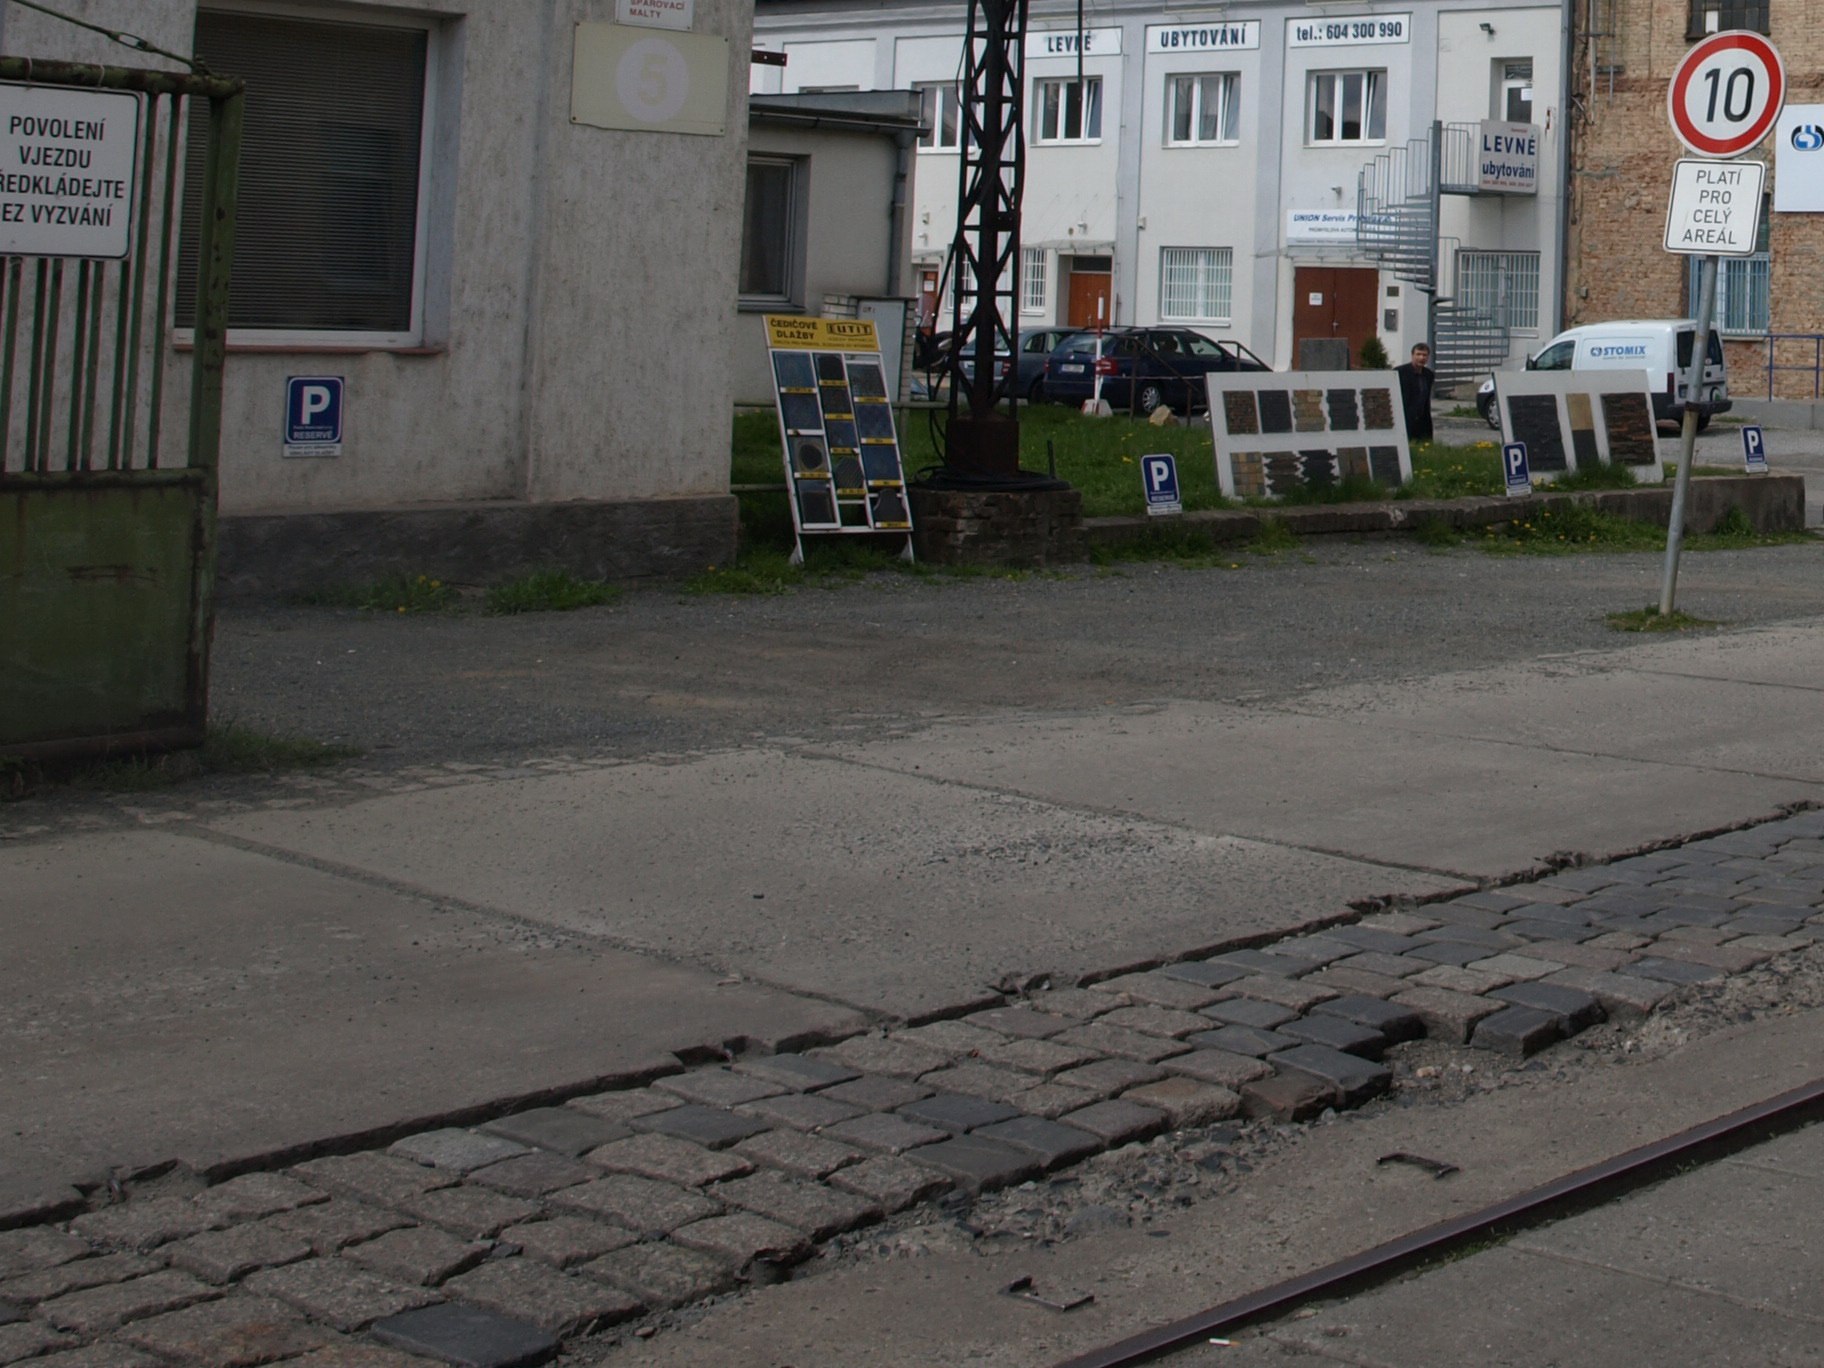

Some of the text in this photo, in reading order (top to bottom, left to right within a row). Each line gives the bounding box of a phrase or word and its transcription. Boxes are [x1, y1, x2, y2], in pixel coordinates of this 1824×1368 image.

[629, 8, 662, 19] MALTY
[1160, 23, 1247, 48] UBYTOVÁNÍ
[1297, 21, 1402, 41] tel.: 604 300 990
[1704, 67, 1755, 123] 10
[9, 115, 106, 141] POVOLENÍ
[1483, 134, 1536, 155] LEVNÉ
[19, 145, 92, 169] VJEZDU
[1482, 160, 1535, 179] ubytování
[1696, 168, 1743, 185] PLATÍ
[1699, 189, 1732, 205] PRO
[31, 202, 113, 227] VYZVÁNÍ
[1693, 207, 1733, 224] CELÝ
[1682, 227, 1737, 245] AREÁL
[770, 318, 818, 330] ČEDIČOVÉ
[776, 330, 815, 340] DLAŽBY
[1603, 345, 1646, 356] STOMIX
[301, 385, 331, 425] P
[1747, 430, 1759, 454] P
[1509, 448, 1522, 475] P
[1150, 460, 1169, 491] P
